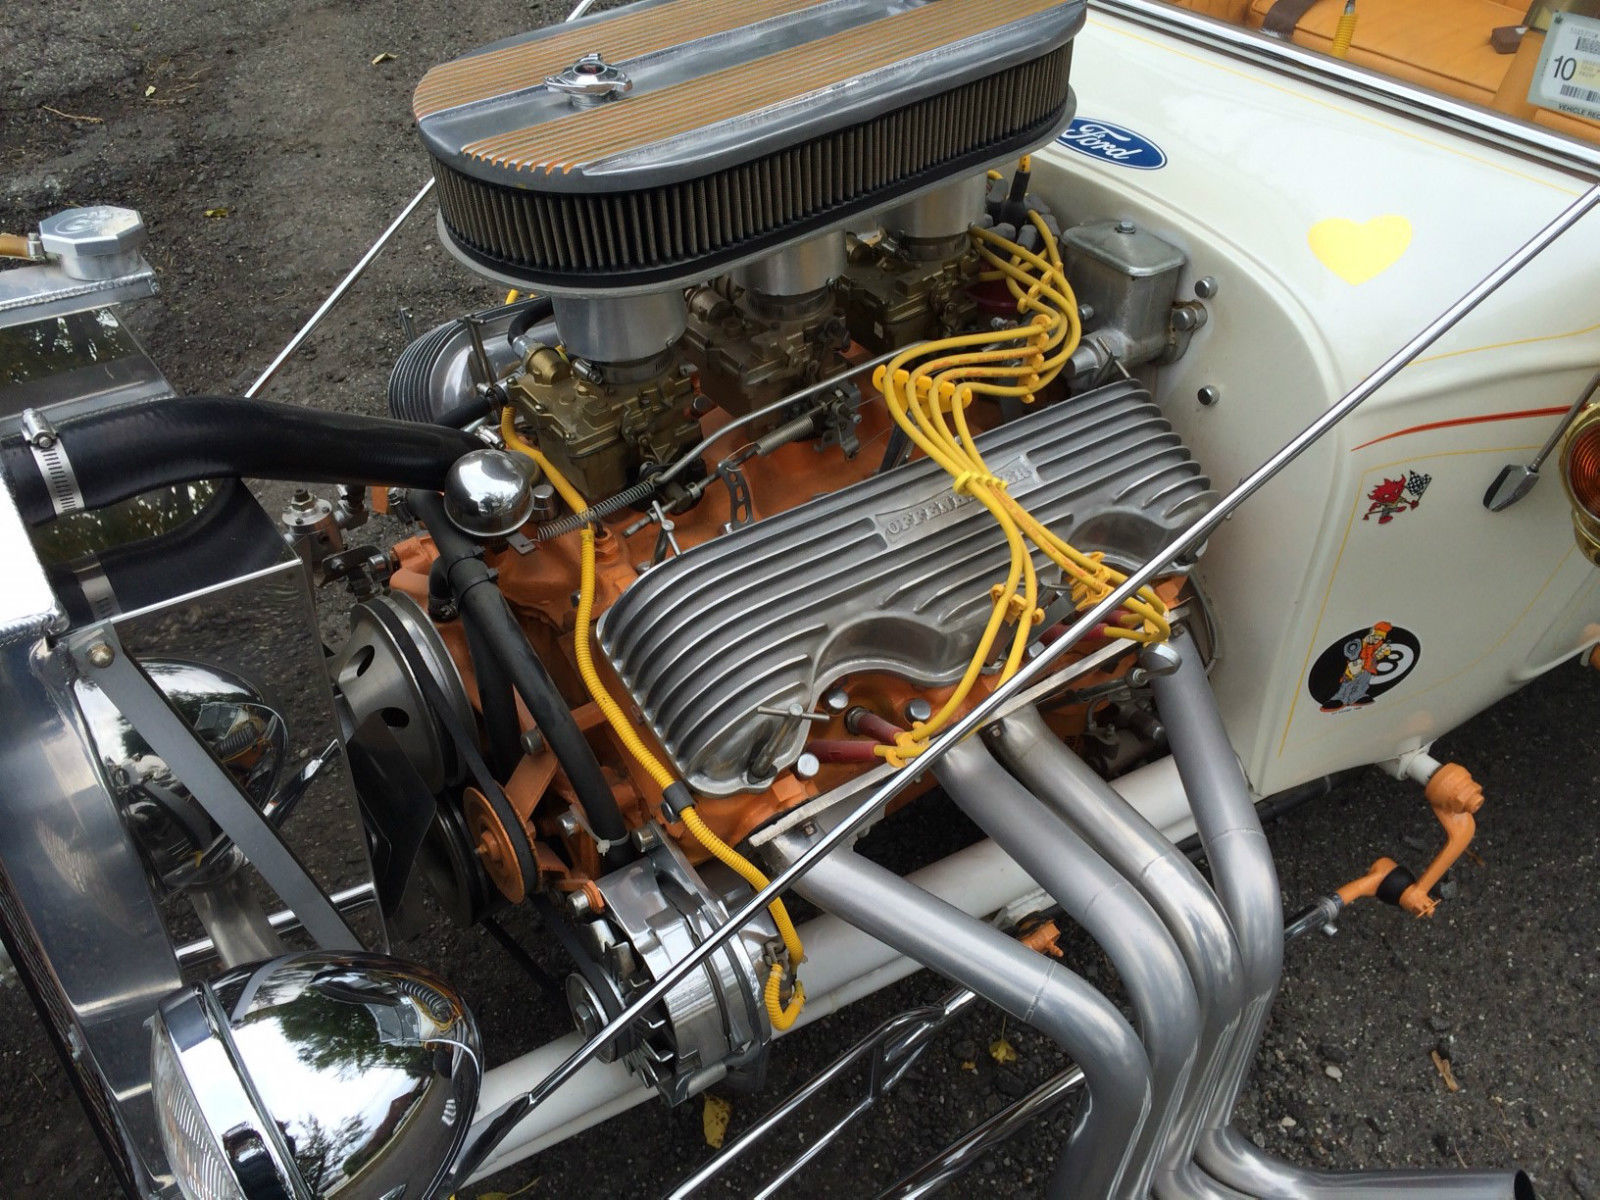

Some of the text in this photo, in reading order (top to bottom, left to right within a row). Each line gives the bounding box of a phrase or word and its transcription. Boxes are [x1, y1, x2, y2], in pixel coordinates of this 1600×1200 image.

[1554, 55, 1577, 81] 10
[1559, 103, 1585, 115] VEHICLE
[1061, 124, 1143, 159] Ford
